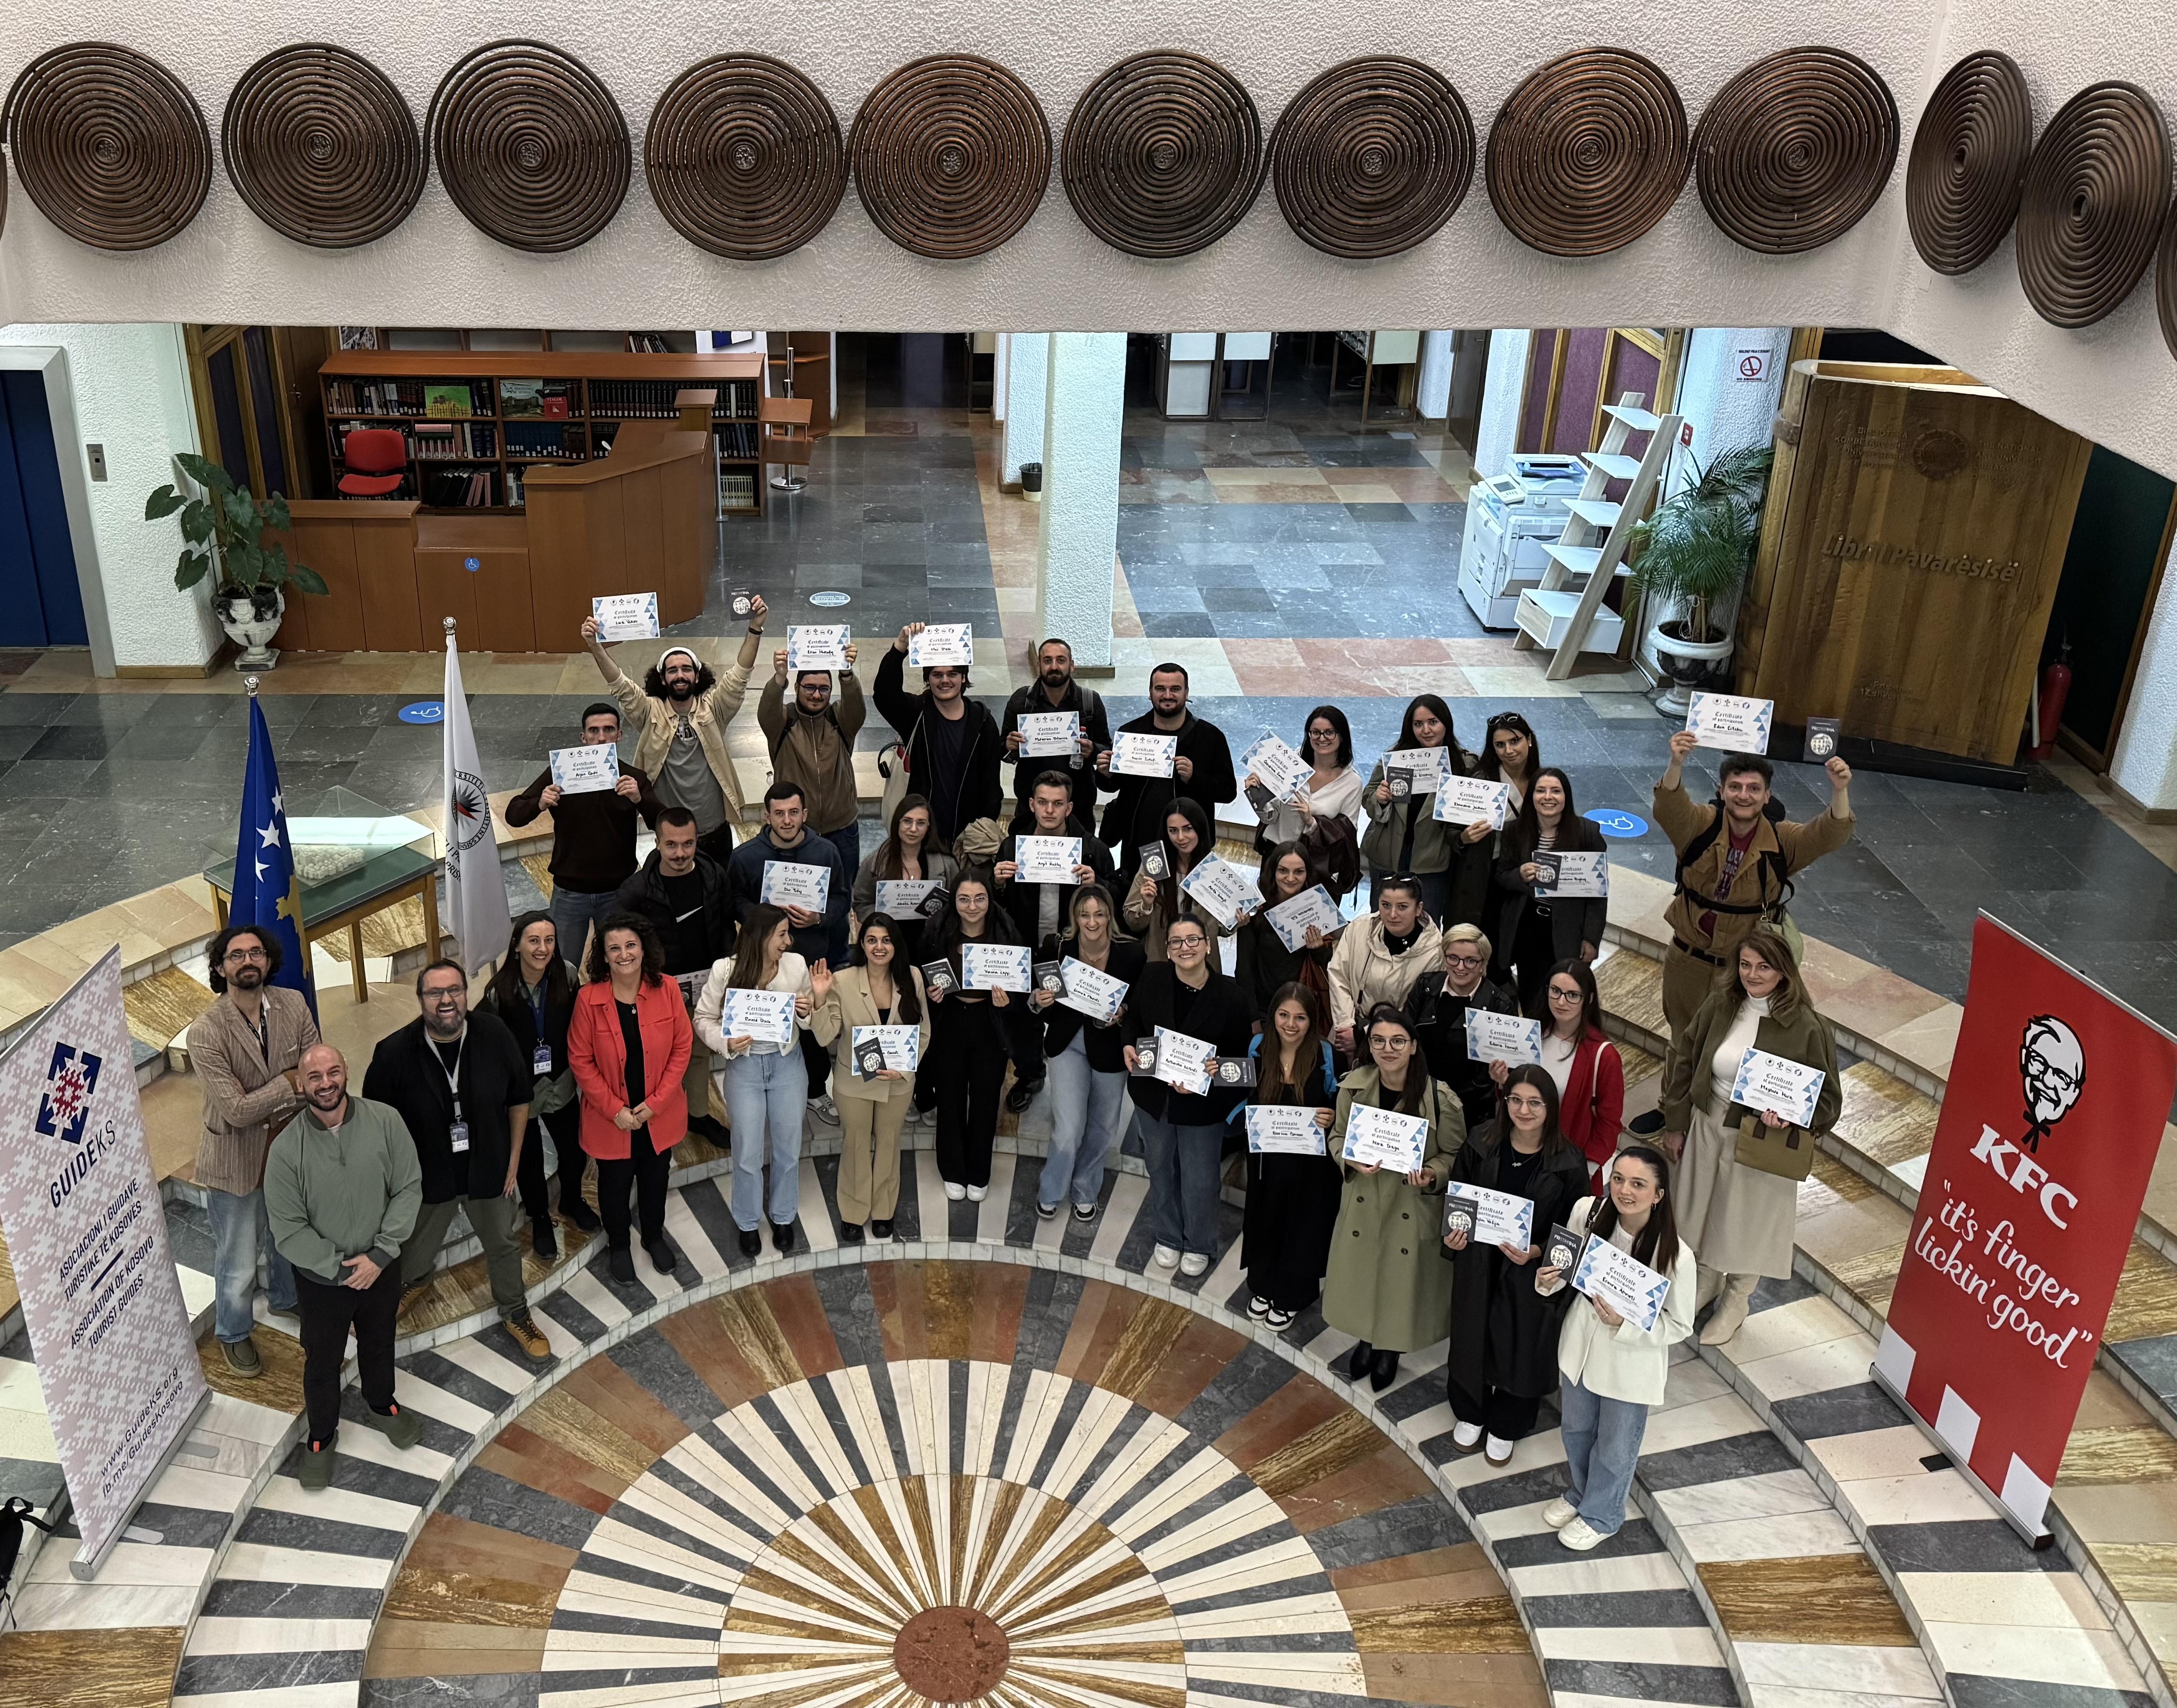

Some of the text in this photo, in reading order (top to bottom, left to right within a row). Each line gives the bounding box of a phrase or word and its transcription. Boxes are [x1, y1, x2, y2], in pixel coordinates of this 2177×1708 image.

[1974, 462, 2012, 472] LIBRARY
[1998, 442, 2041, 453] NATIONAL
[51, 1120, 115, 1208] GUIDEKS
[1970, 1123, 2078, 1230] KFC
[60, 1178, 138, 1282] ASOCIACIONI I GUIDAVE
[64, 1200, 142, 1302] TURISTIKE TË KOSOVËS
[1984, 1220, 2080, 1309] finger
[71, 1235, 154, 1350] ASSOCIATION OF KOSOVO
[89, 1273, 143, 1350] TOURIST GUIDES
[1914, 1216, 2093, 1369] lickin' good"
[101, 1367, 178, 1477] www.GuideKS.org
